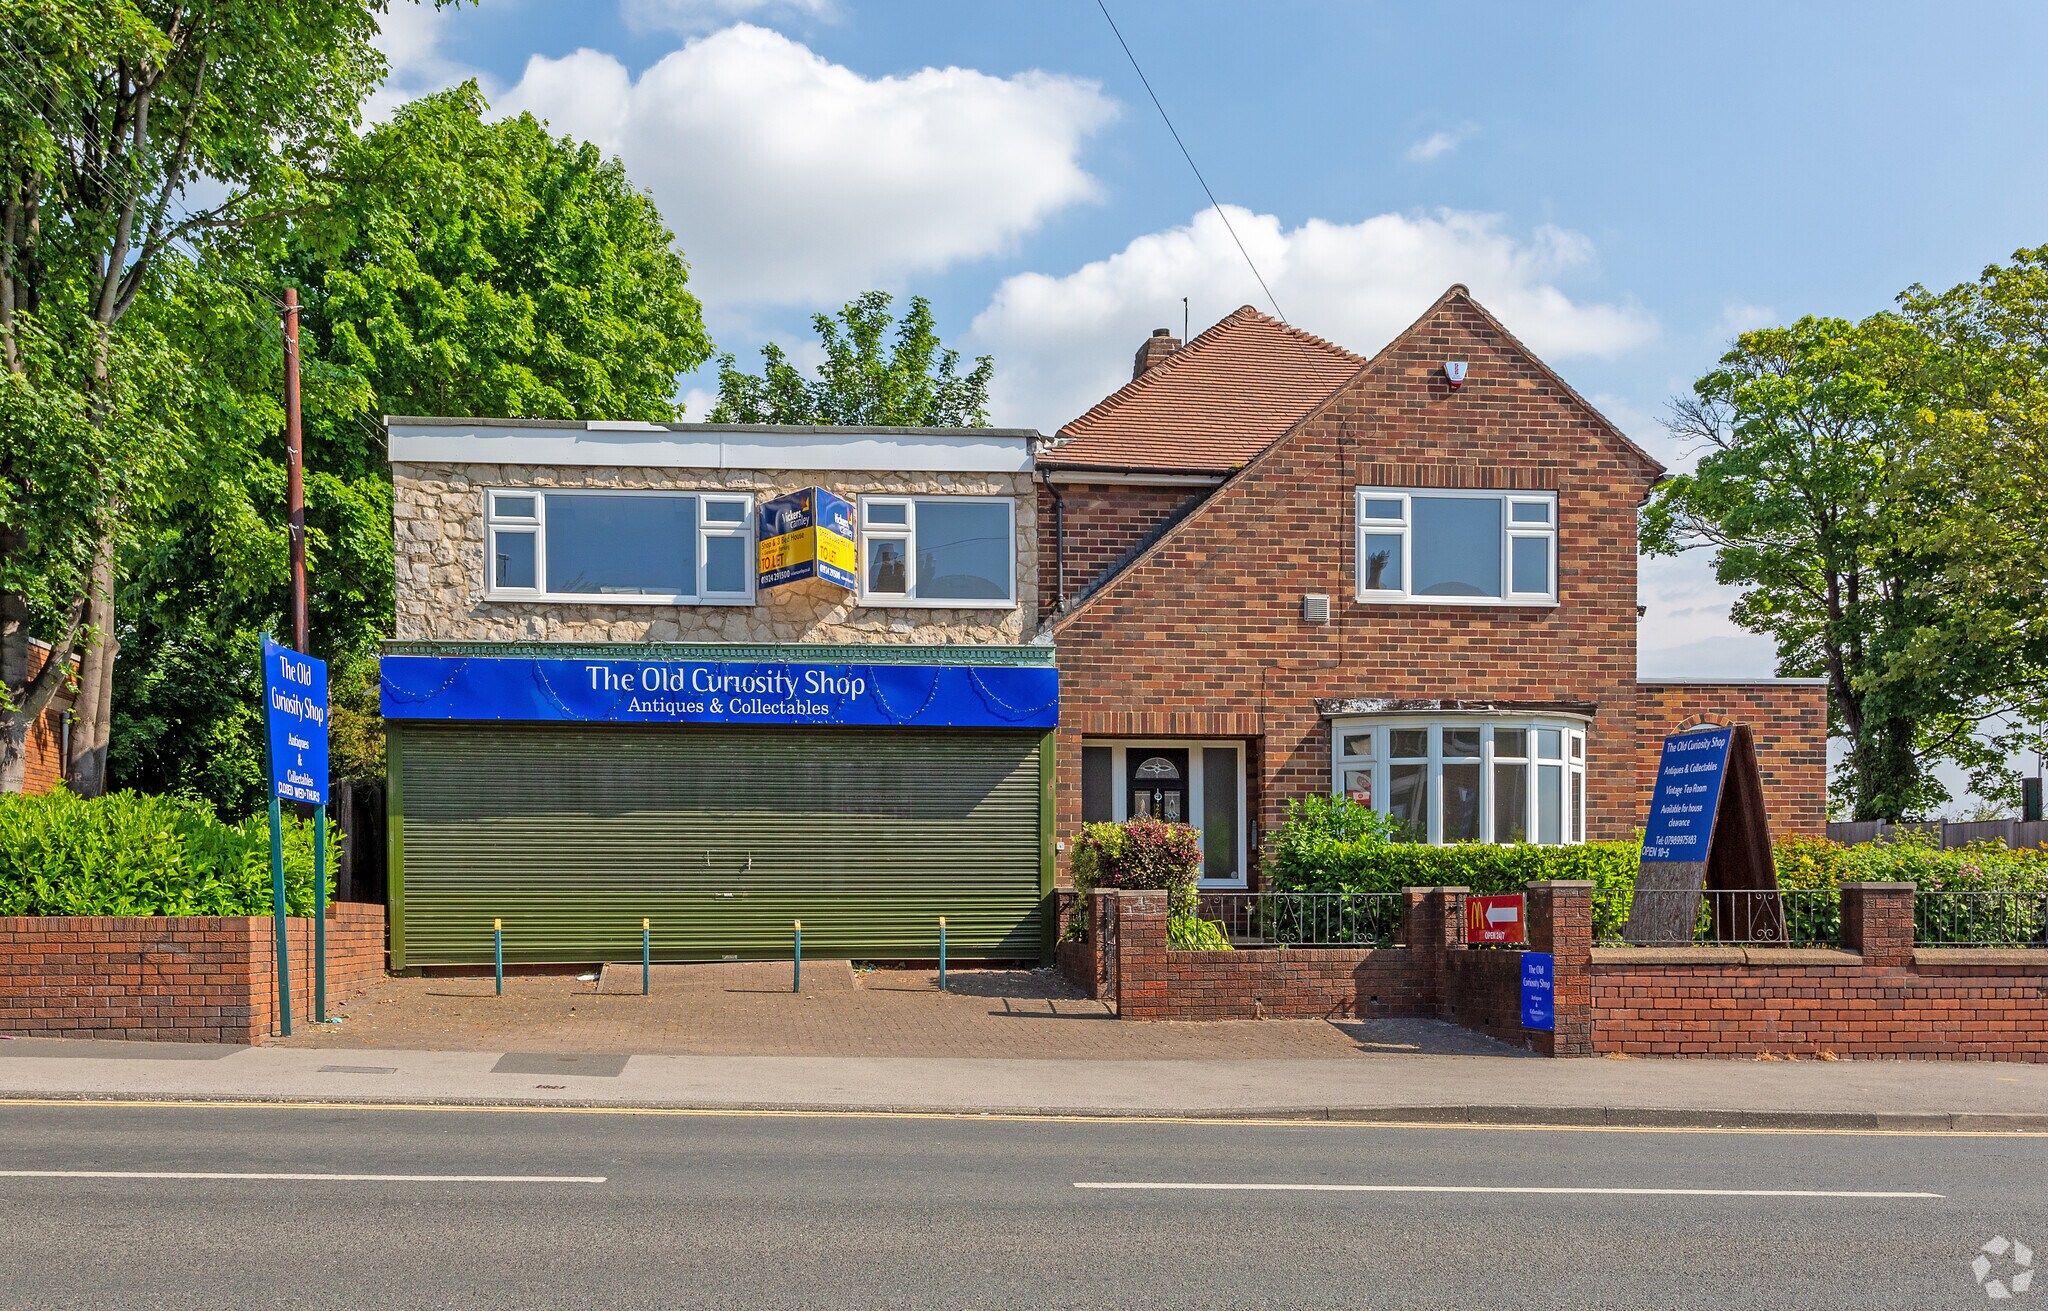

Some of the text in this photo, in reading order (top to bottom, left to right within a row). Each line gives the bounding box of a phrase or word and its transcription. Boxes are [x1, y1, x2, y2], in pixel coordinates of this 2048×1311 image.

[820, 545, 828, 560] TO
[761, 554, 784, 571] TO LET
[280, 655, 311, 687] The Old
[585, 665, 866, 701] The Old Curiosity Shop
[271, 686, 324, 727] Curiosity Shop
[627, 697, 829, 716] Antiques & Collectables
[288, 732, 310, 751] Antiques
[1667, 736, 1726, 753] The Old Curiosity Shop
[297, 753, 303, 766] &
[1664, 761, 1718, 777] Antiques & Collectables
[287, 769, 314, 787] Collectables
[278, 781, 294, 796] CLOSED
[1666, 783, 1708, 797] Vintage Tea Room
[1660, 803, 1703, 814] Available for house
[1668, 818, 1691, 828] clearance
[1642, 846, 1657, 857] OPEN
[1484, 931, 1495, 940] OPEN
[1528, 964, 1545, 975] The Old
[1523, 977, 1551, 991] Curiosity Shop
